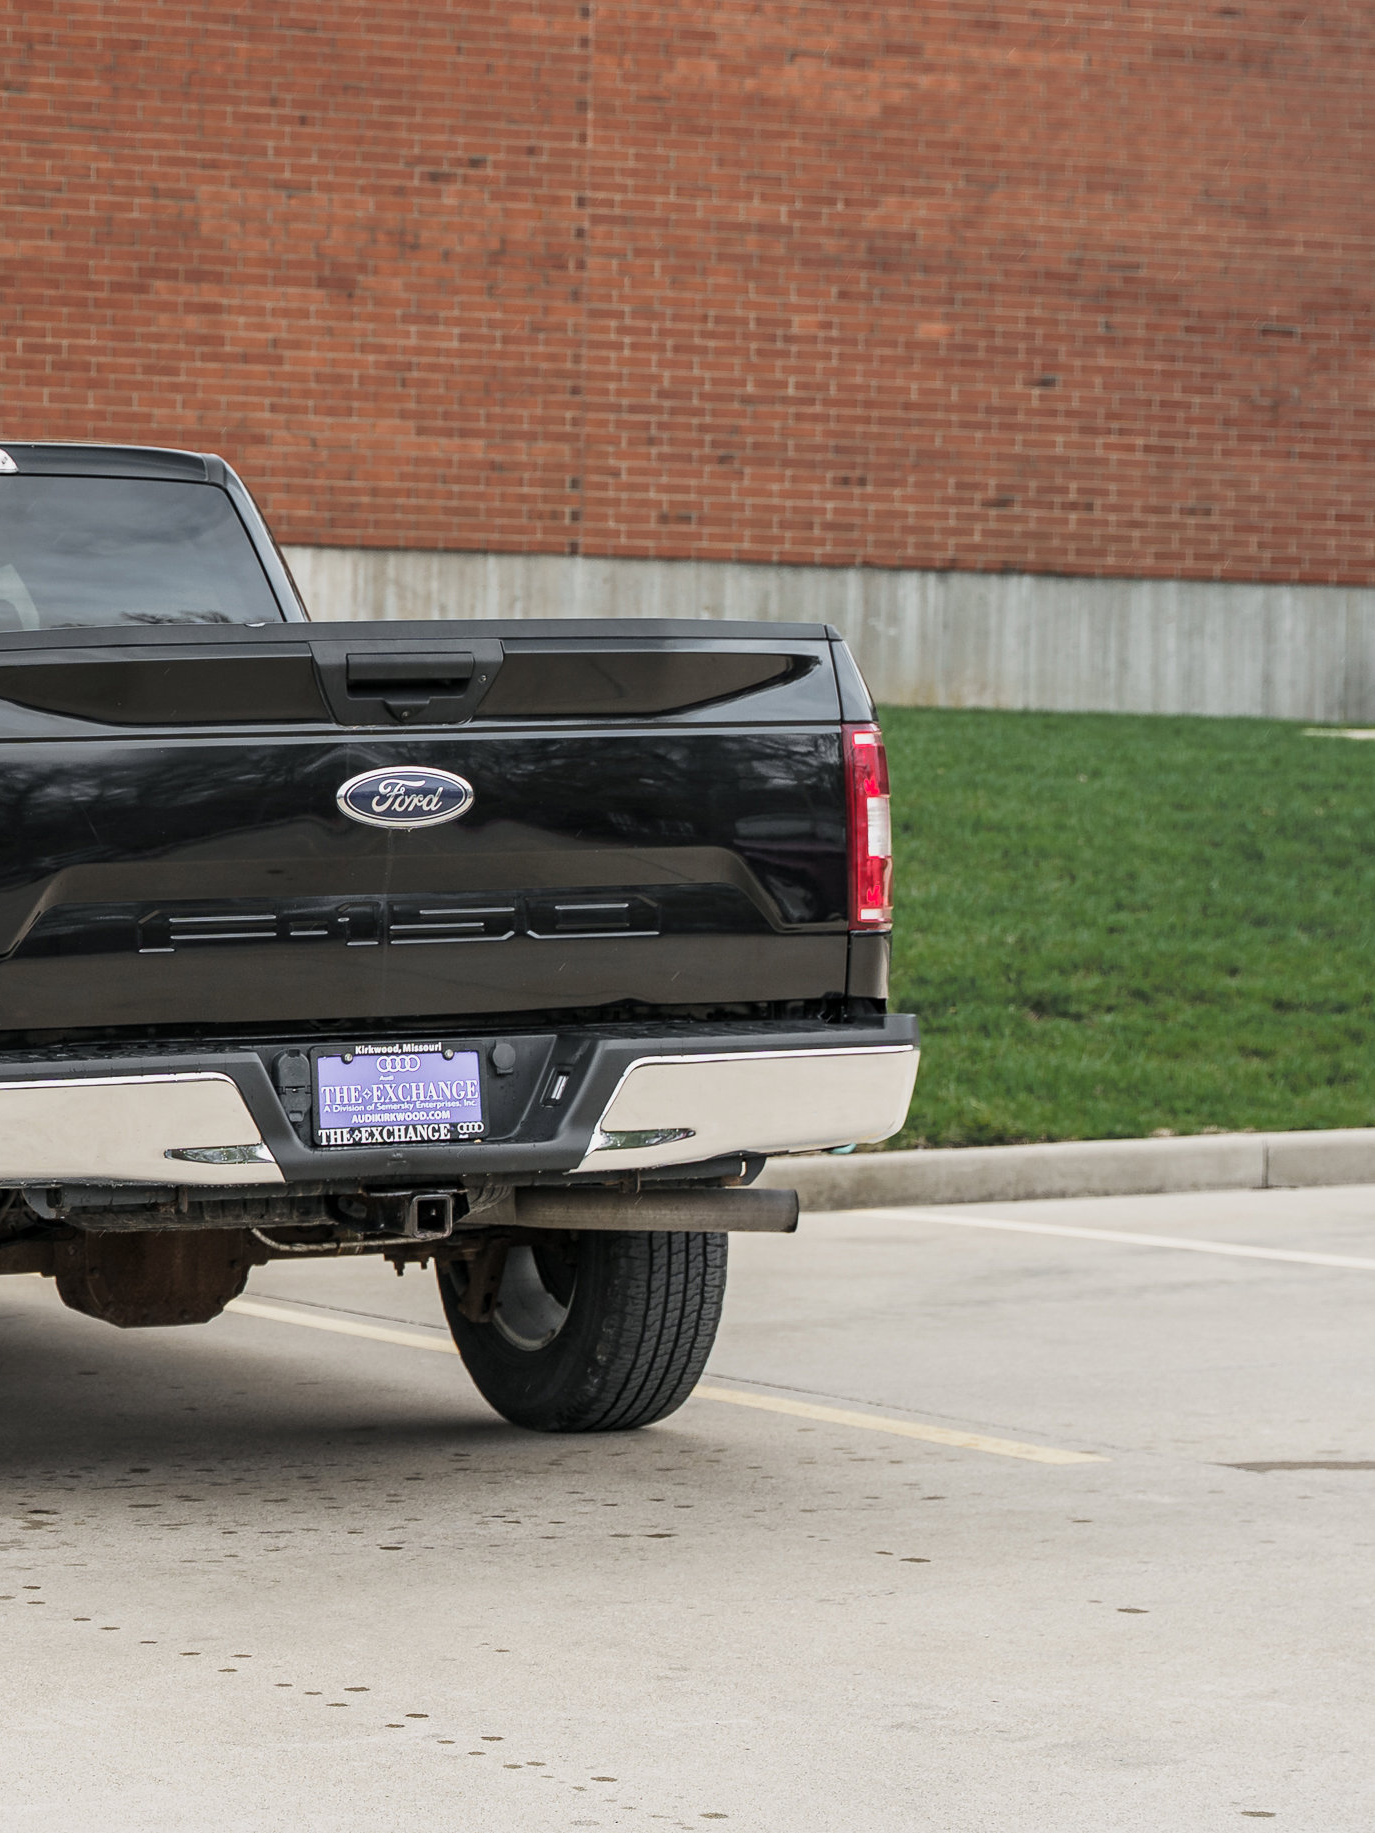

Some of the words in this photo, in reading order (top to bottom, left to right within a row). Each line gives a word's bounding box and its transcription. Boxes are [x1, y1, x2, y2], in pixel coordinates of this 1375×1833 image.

[371, 778, 444, 813] Ford
[355, 1043, 401, 1054] Kirkwood,
[402, 1042, 442, 1053] Missouri
[323, 1105, 331, 1113] A
[332, 1104, 365, 1112] Division
[366, 1103, 375, 1111] of
[376, 1101, 414, 1111] Semersky
[351, 1110, 451, 1124] AUDIKIRKWOOD.COM
